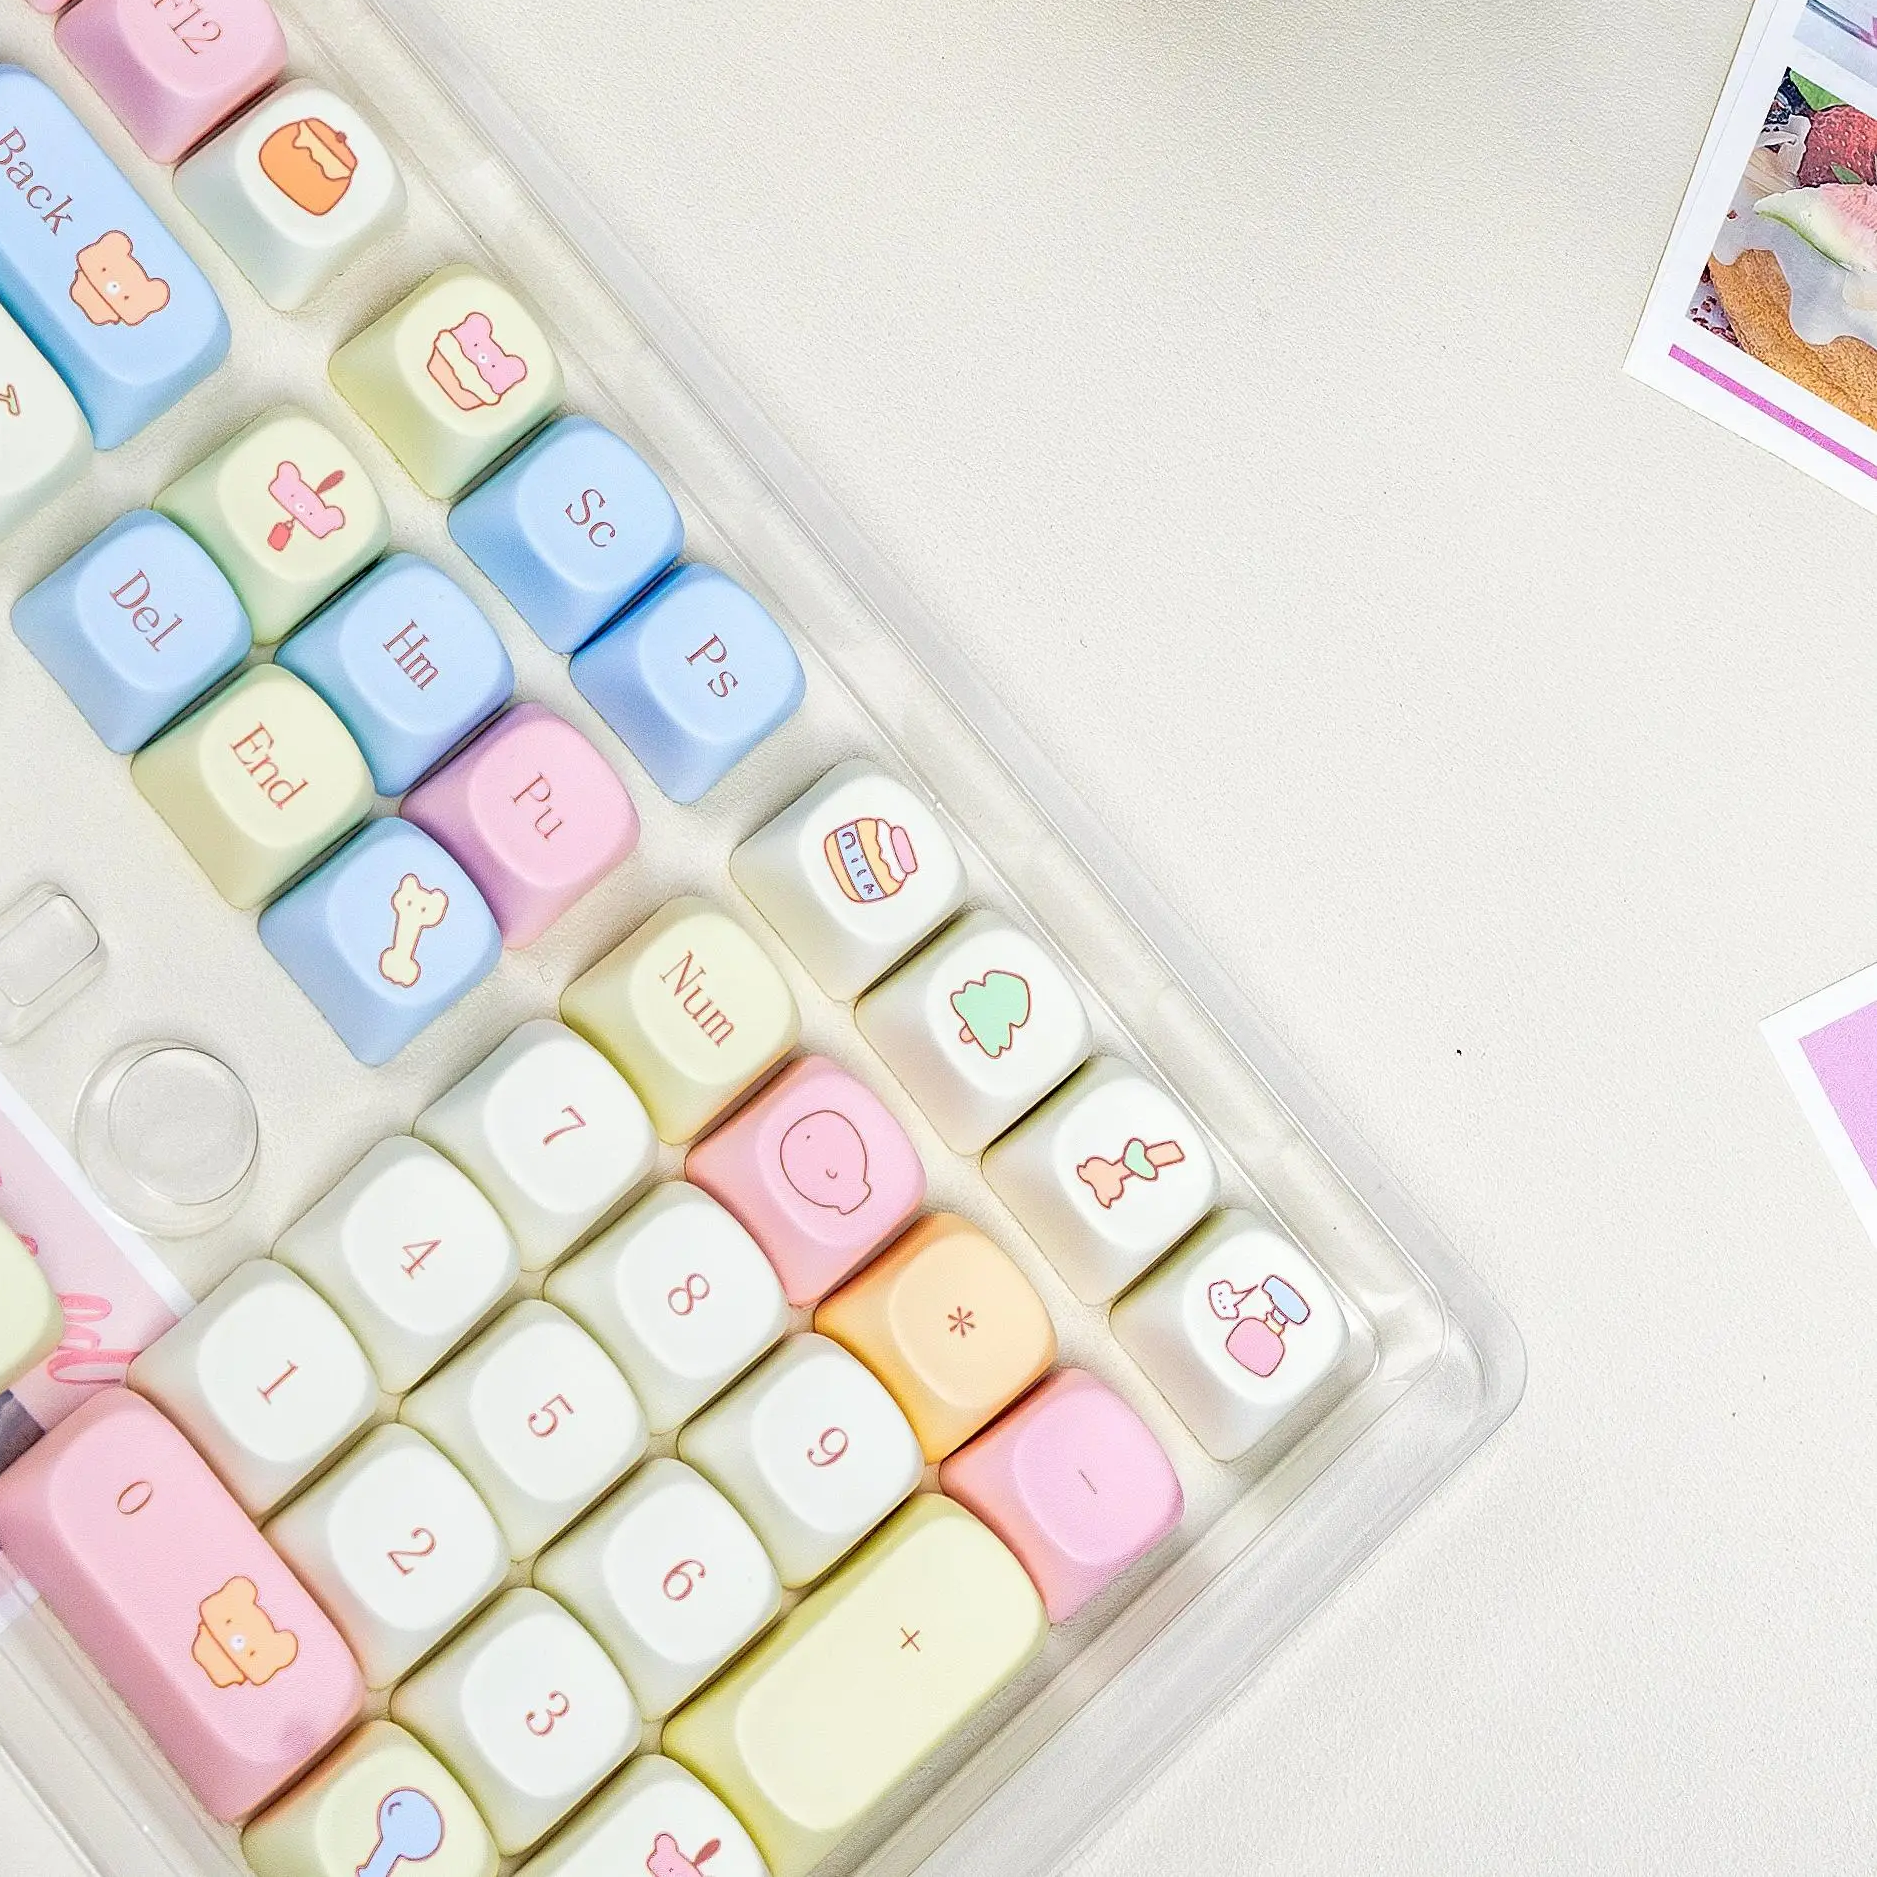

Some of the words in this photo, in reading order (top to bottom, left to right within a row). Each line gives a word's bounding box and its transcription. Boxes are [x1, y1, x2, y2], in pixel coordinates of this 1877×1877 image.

[565, 489, 615, 547] Sc
[110, 569, 183, 652] Del
[383, 619, 438, 690] Hm
[685, 633, 738, 698] Ps
[230, 722, 309, 810] End
[513, 772, 563, 839] Pu
[660, 951, 734, 1047] Num
[543, 1106, 586, 1145] 7
[401, 1240, 441, 1279] 4
[668, 1273, 710, 1316] 8
[528, 1394, 574, 1437] 5
[807, 1427, 848, 1467] 9
[387, 1528, 436, 1576] 2
[663, 1559, 706, 1601] 6
[526, 1691, 570, 1736] 3
